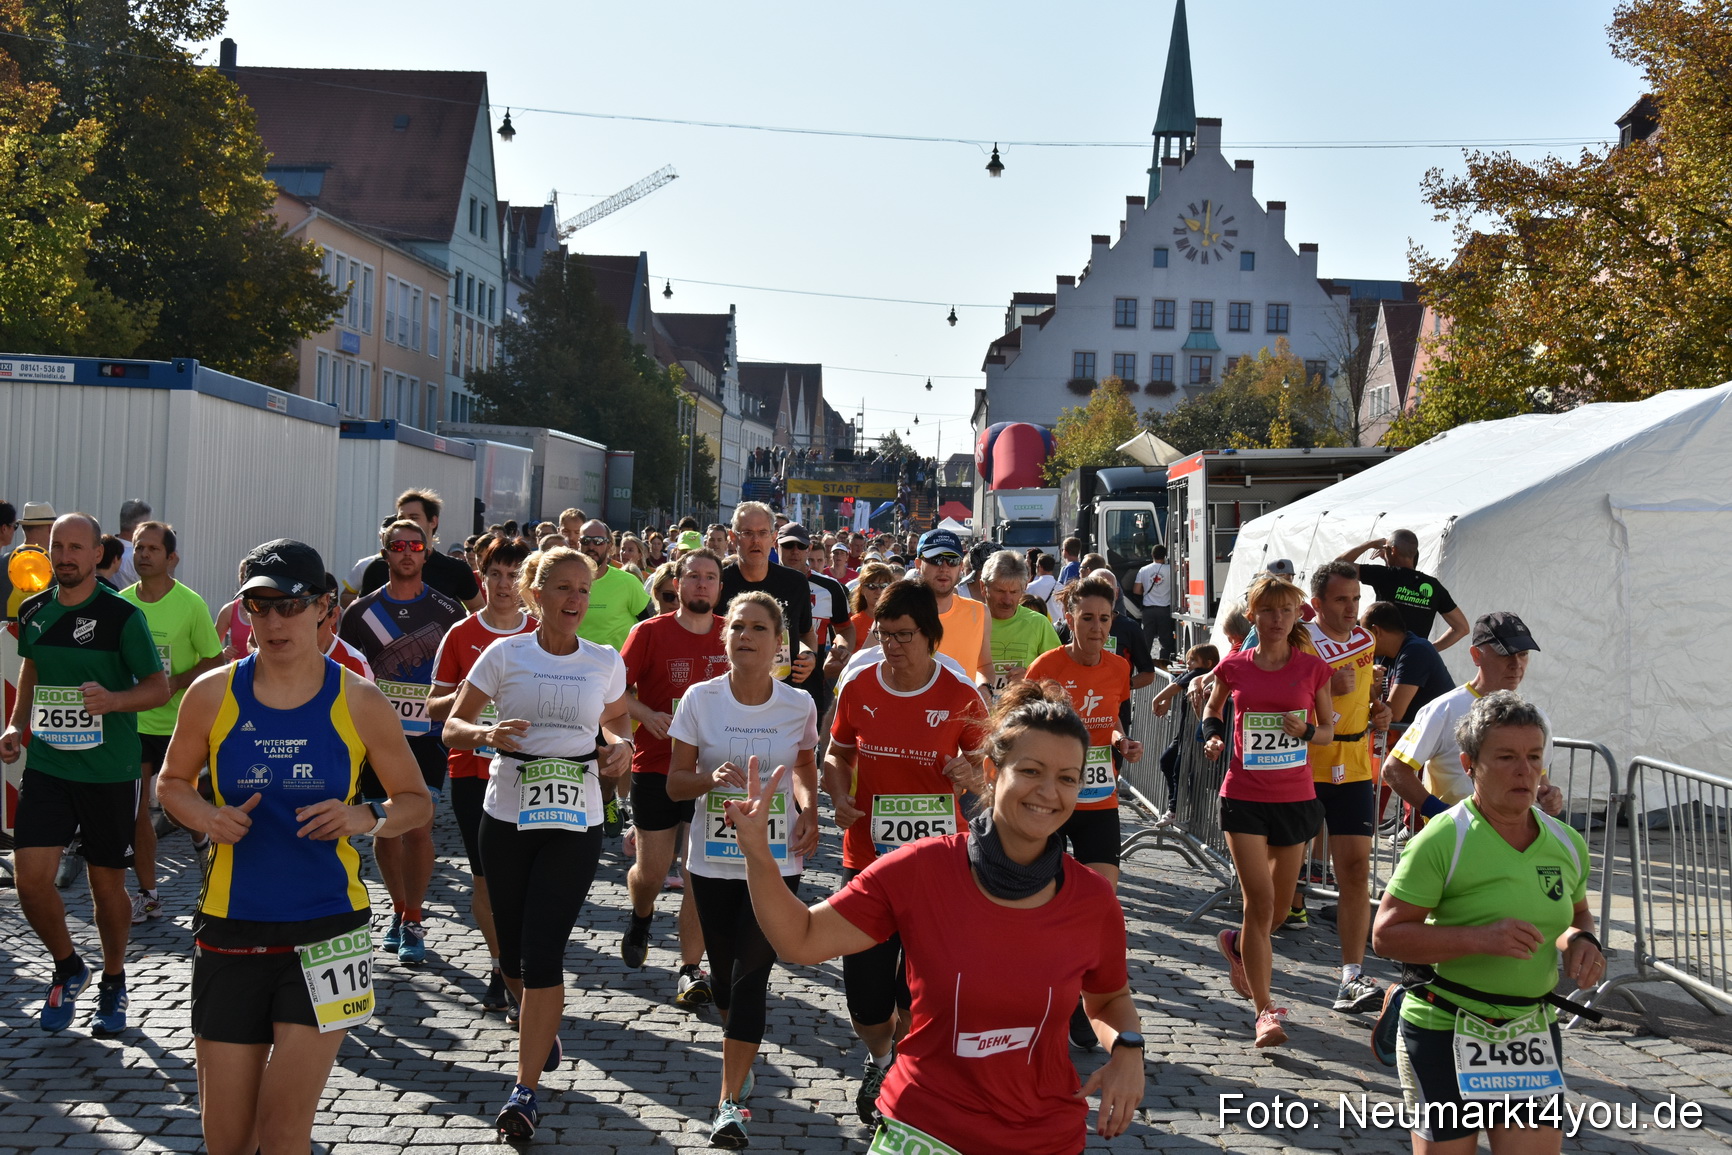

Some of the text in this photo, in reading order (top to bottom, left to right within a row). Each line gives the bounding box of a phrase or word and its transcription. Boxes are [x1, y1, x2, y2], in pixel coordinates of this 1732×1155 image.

[822, 484, 861, 494] START
[1396, 586, 1420, 596] physio
[438, 598, 456, 614] GROH
[1394, 594, 1430, 606] neumarkt
[534, 672, 586, 682] ZAHNARZTPRAXIS
[380, 683, 425, 696] BOCK
[390, 700, 425, 718] 707
[38, 709, 94, 728] 2659
[724, 726, 778, 734] ZAHNARZTPRAXIS
[38, 733, 94, 742] CHRISTIAN
[858, 740, 898, 753] ENGELHARDT
[909, 749, 938, 758] WALTER
[1087, 749, 1106, 761] CK
[1257, 754, 1296, 764] RENATE
[293, 764, 313, 778] FR
[527, 763, 579, 780] BOCK
[1086, 766, 1107, 784] 38
[528, 783, 579, 806] 2157
[881, 799, 945, 812] BOCK
[528, 811, 578, 823] KRISTINA
[715, 817, 776, 839] 21
[881, 820, 946, 841] 2085
[722, 846, 744, 856] JUL
[1545, 876, 1562, 896] F C
[1466, 1016, 1540, 1040] BOCK
[977, 1035, 1012, 1050] DEHN
[1466, 1038, 1544, 1066] 2486
[1469, 1075, 1552, 1089] CHRISTINE
[882, 1129, 948, 1155] BO
